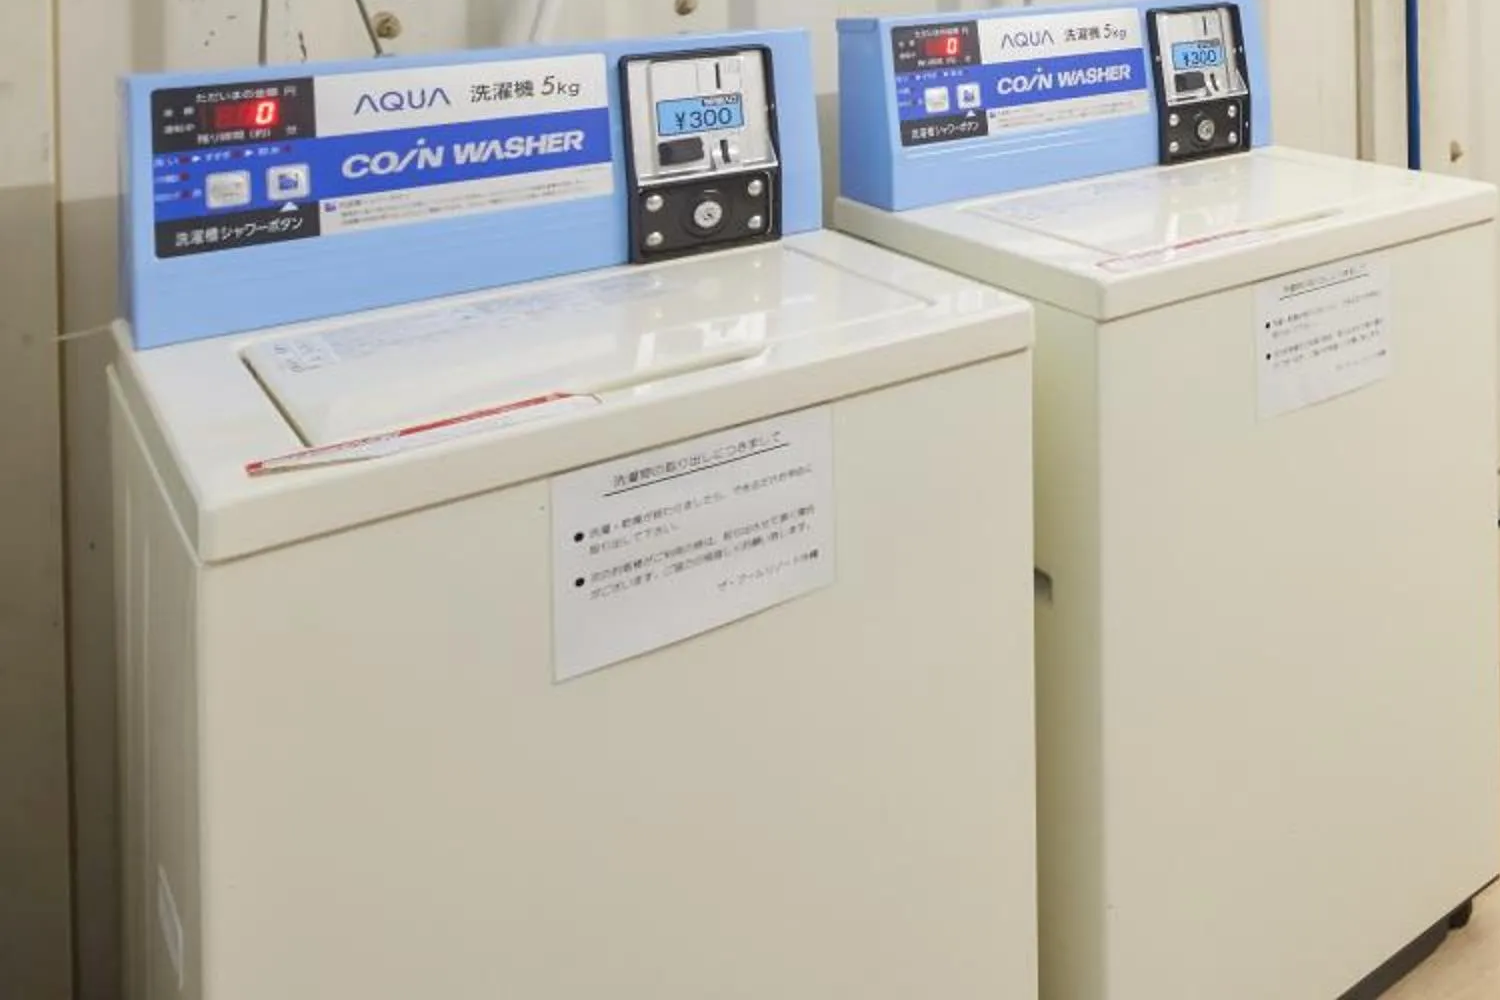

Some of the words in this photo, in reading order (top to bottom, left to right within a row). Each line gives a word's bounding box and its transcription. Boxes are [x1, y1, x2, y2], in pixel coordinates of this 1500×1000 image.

[947, 37, 957, 55] 0
[1001, 30, 1054, 49] AQUA
[1057, 63, 1132, 88] WASHER
[354, 87, 452, 115] AQUA
[470, 80, 535, 103] 洗濯機
[541, 75, 581, 97] 5kg
[254, 101, 276, 125] 0
[674, 107, 733, 131] ¥300
[453, 130, 585, 165] WASHER
